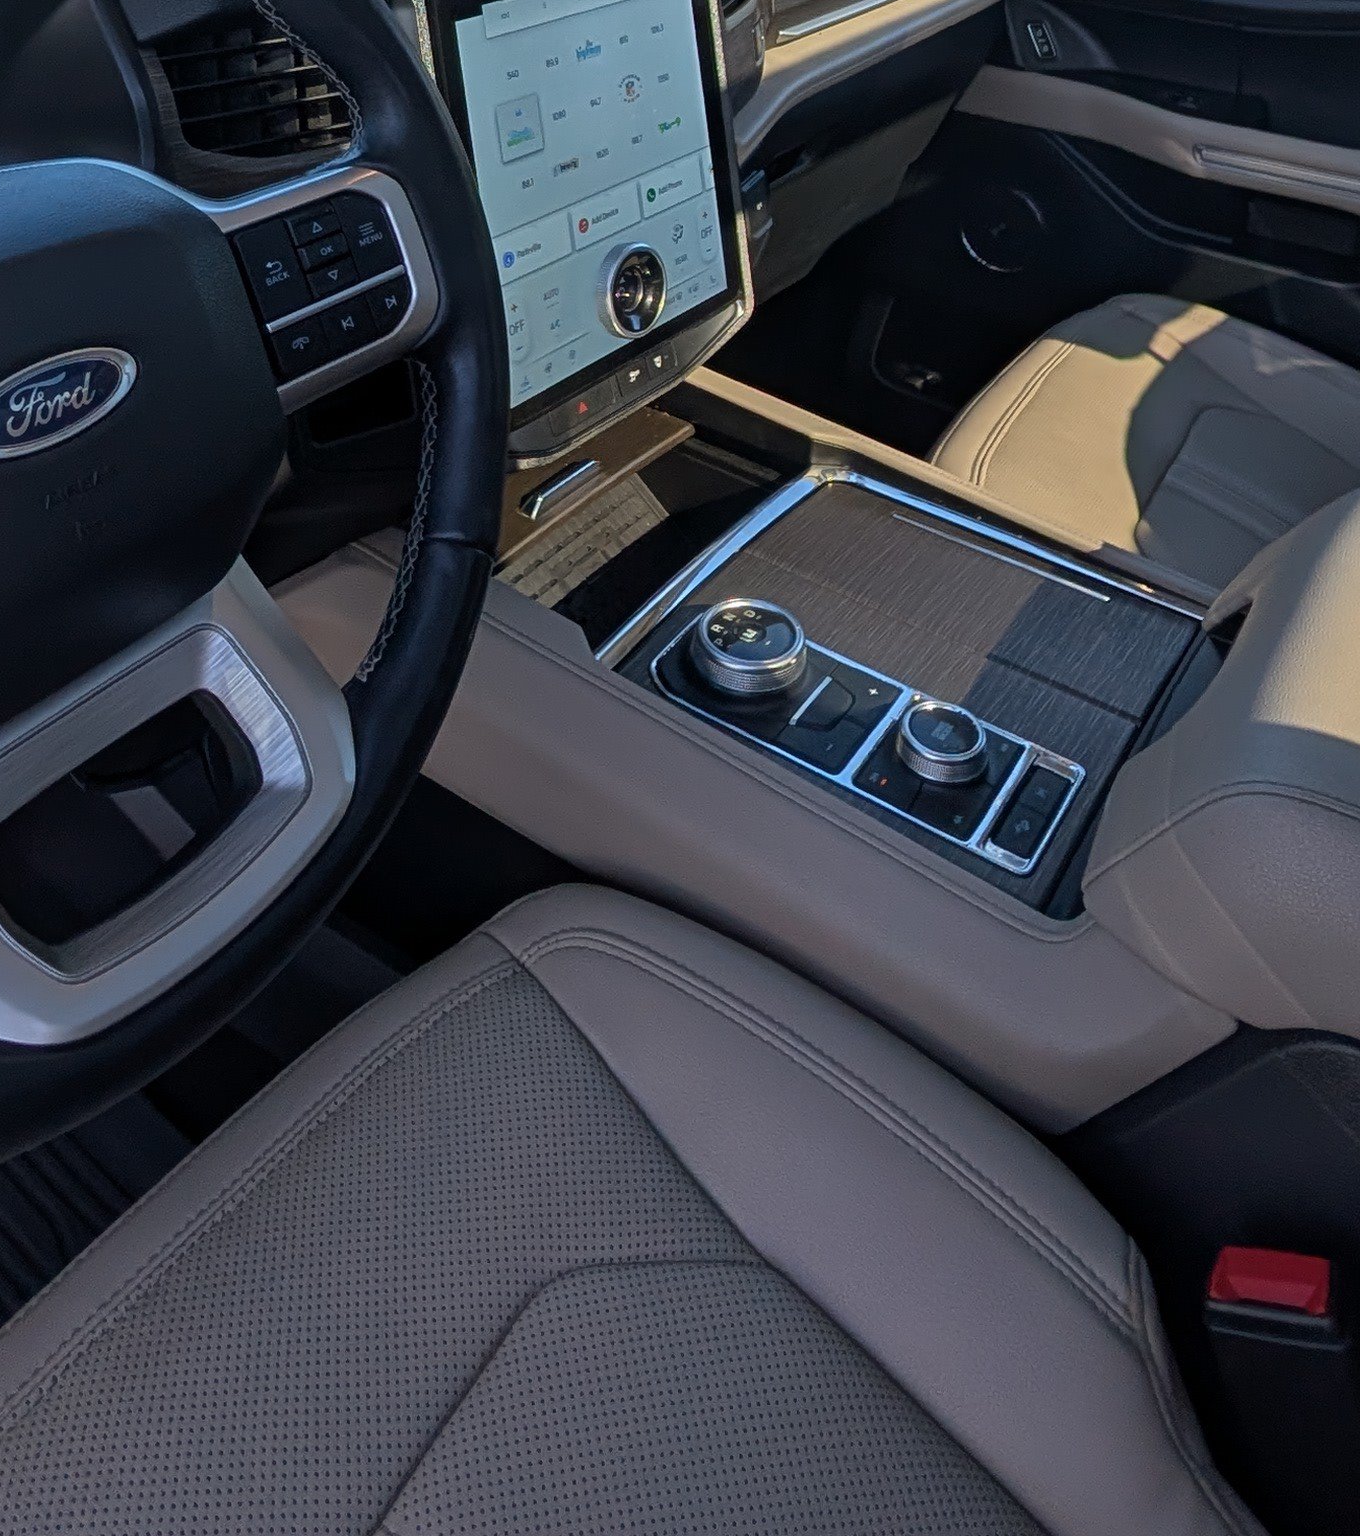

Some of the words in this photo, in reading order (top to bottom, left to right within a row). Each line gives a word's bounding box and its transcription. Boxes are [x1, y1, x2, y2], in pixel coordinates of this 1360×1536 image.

[359, 229, 384, 248] MENU
[700, 227, 714, 239] OFF
[319, 244, 335, 256] OK
[265, 268, 291, 287] BACK
[509, 320, 526, 336] OFF
[6, 370, 96, 438] Ford
[743, 609, 756, 618] D
[710, 624, 725, 633] R
